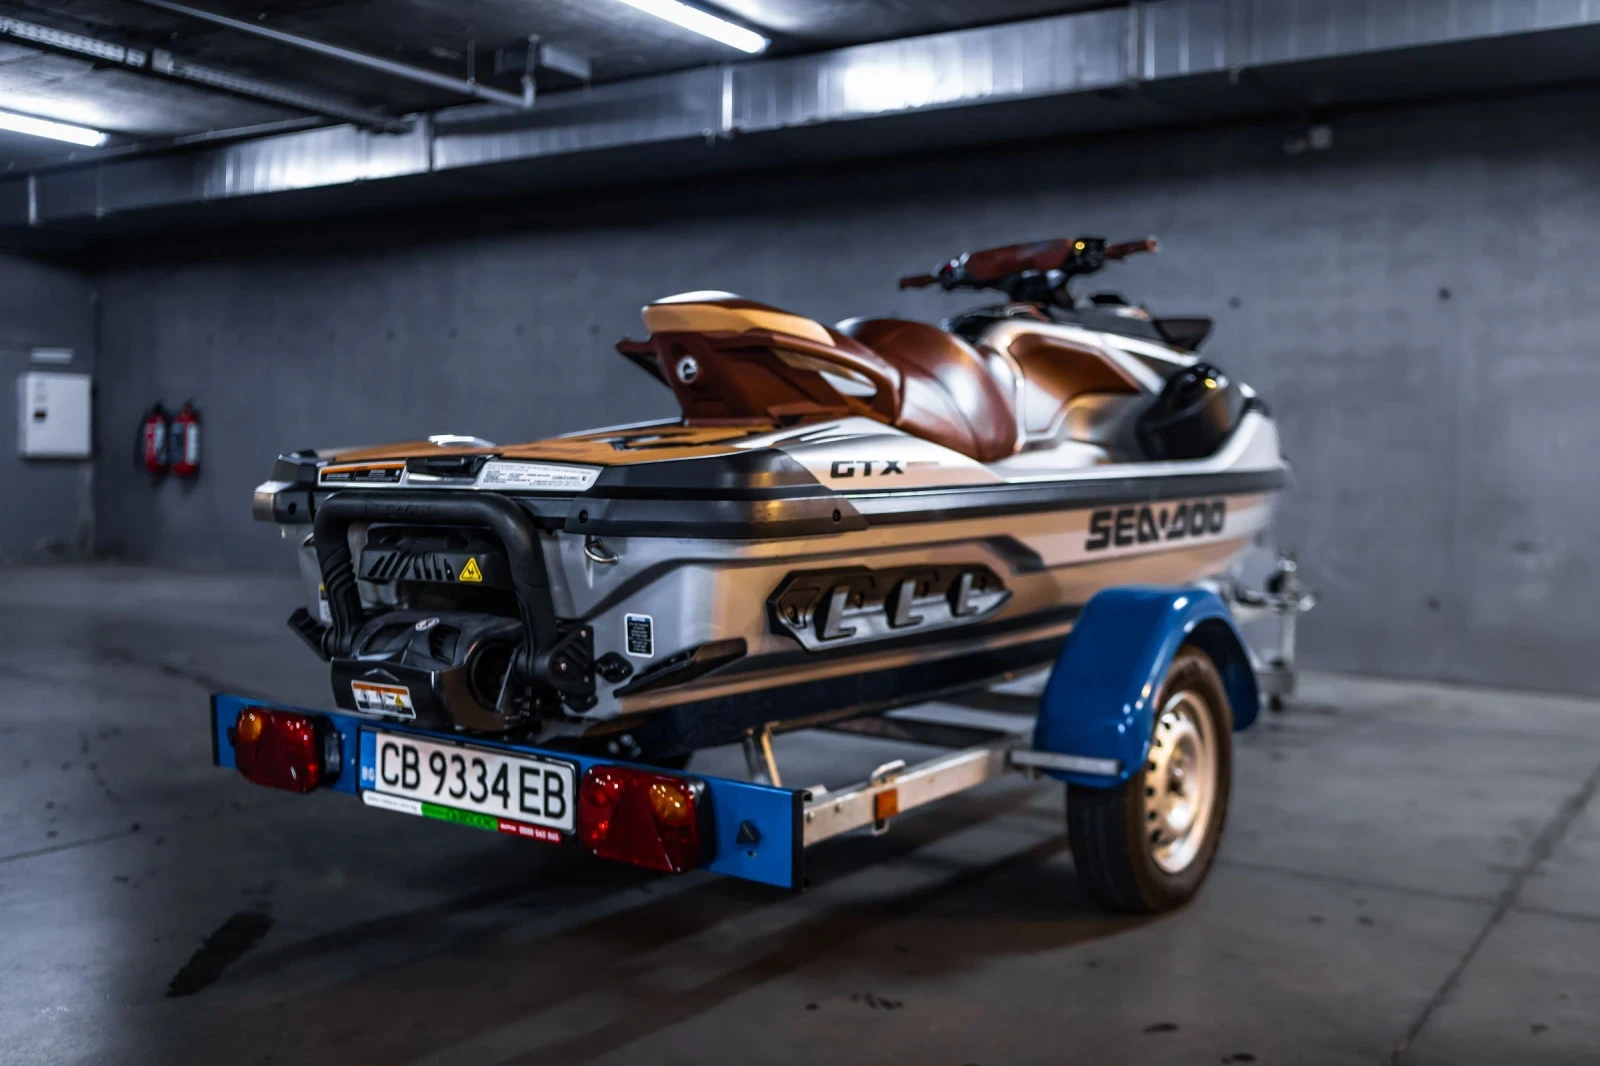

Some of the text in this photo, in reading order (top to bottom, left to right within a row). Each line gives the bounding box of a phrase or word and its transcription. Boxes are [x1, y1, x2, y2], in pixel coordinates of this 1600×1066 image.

[830, 460, 904, 479] GTX
[381, 741, 566, 820] CB 9334 EB
